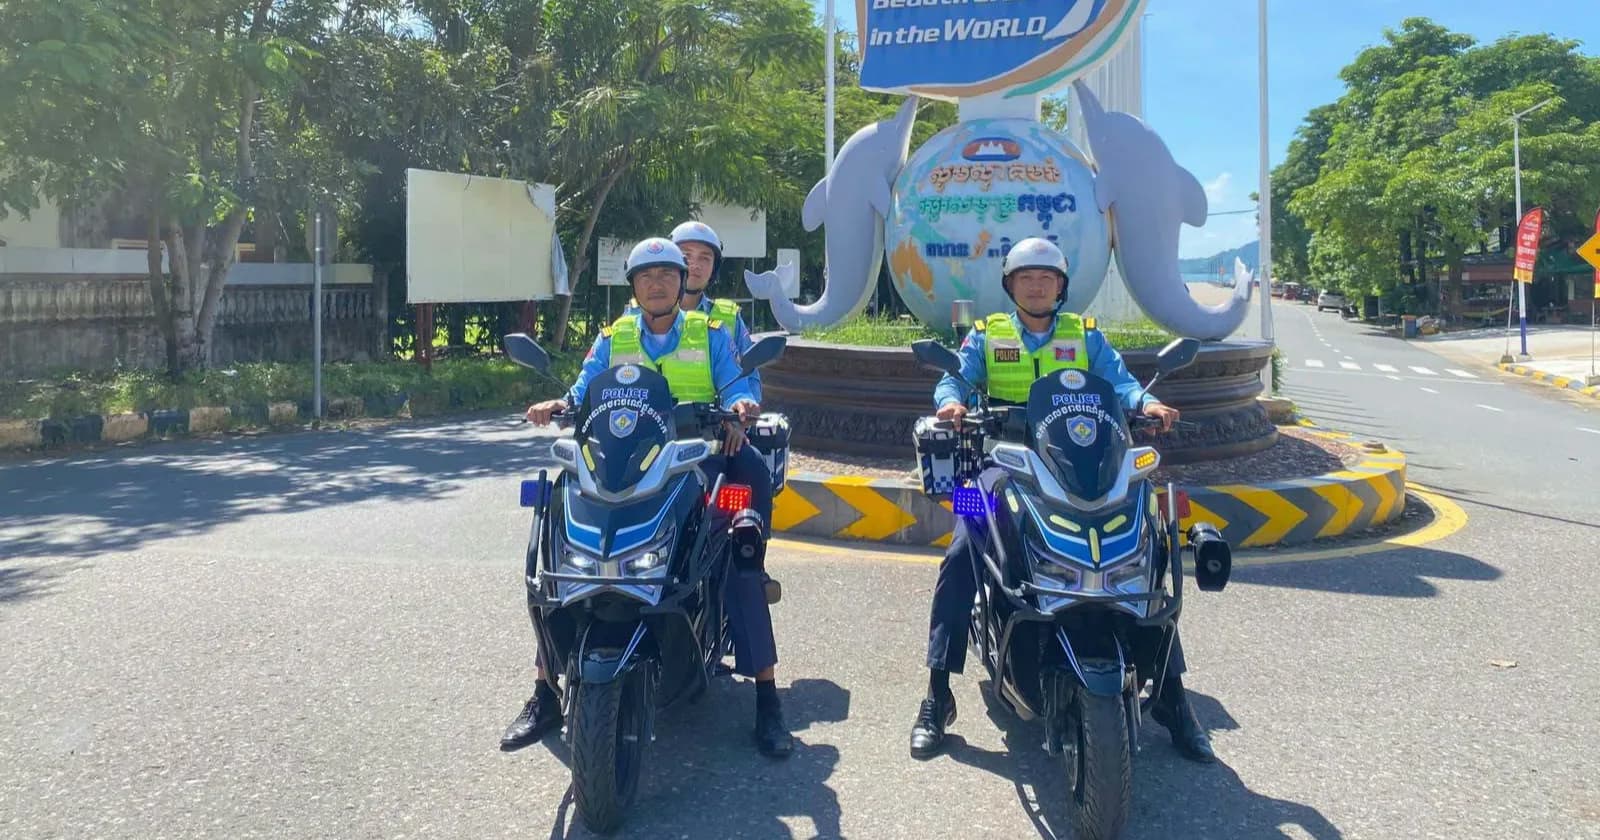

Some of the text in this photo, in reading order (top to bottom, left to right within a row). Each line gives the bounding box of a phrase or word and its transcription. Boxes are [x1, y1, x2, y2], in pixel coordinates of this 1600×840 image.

[869, 28, 892, 46] in
[895, 26, 940, 44] the
[995, 350, 1019, 361] POLICE
[602, 388, 648, 400] POLICE
[1051, 393, 1101, 406] POLICE
